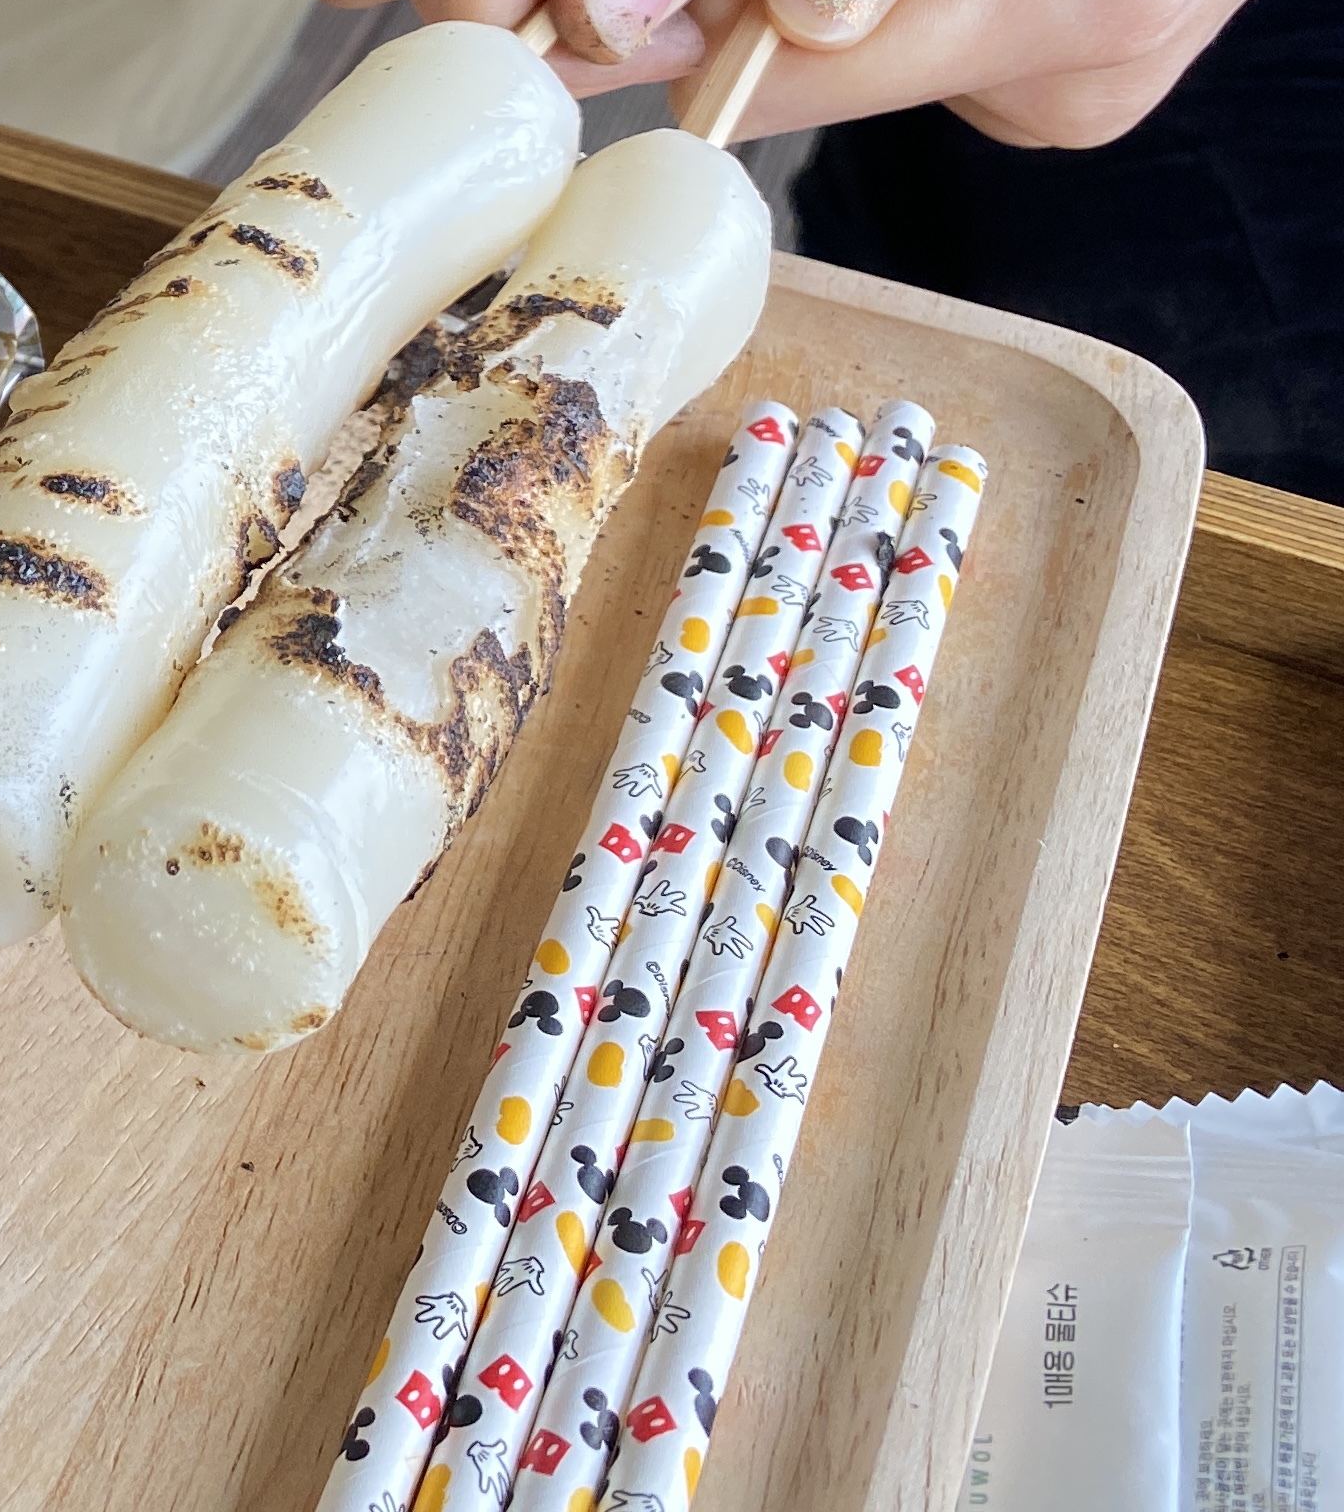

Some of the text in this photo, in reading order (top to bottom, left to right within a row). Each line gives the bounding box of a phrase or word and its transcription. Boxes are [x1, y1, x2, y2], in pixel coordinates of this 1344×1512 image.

[1043, 1283, 1079, 1409] 1매용 물티슈
[968, 1433, 993, 1512] UWOL
